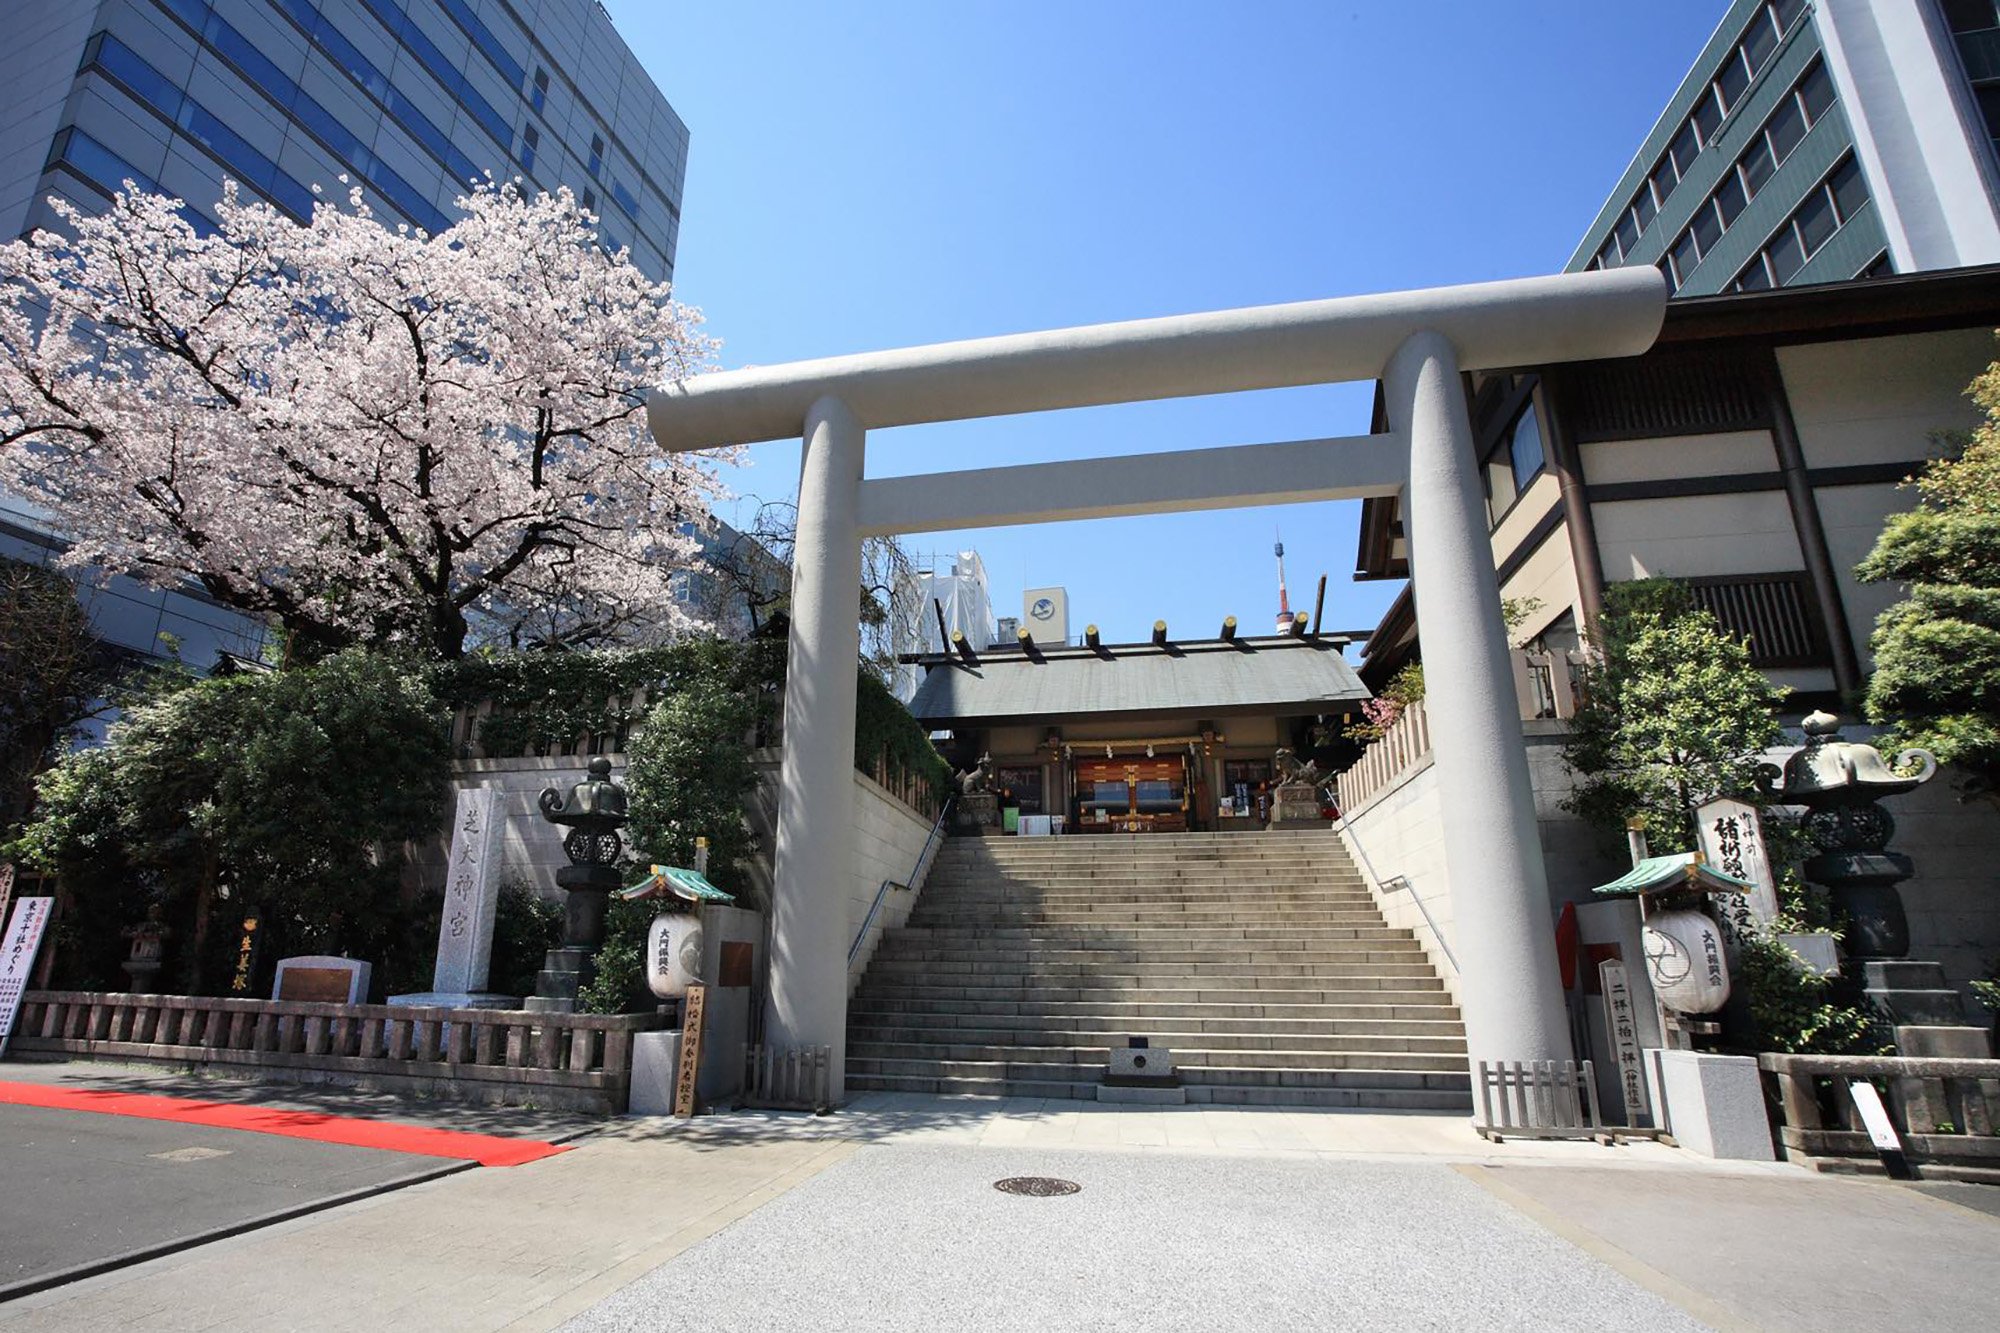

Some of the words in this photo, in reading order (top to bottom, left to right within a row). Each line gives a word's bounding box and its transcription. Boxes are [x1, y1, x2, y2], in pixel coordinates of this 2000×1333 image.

[452, 810, 479, 937] 芝大神宮
[7, 900, 37, 975] 東京十社めぐり
